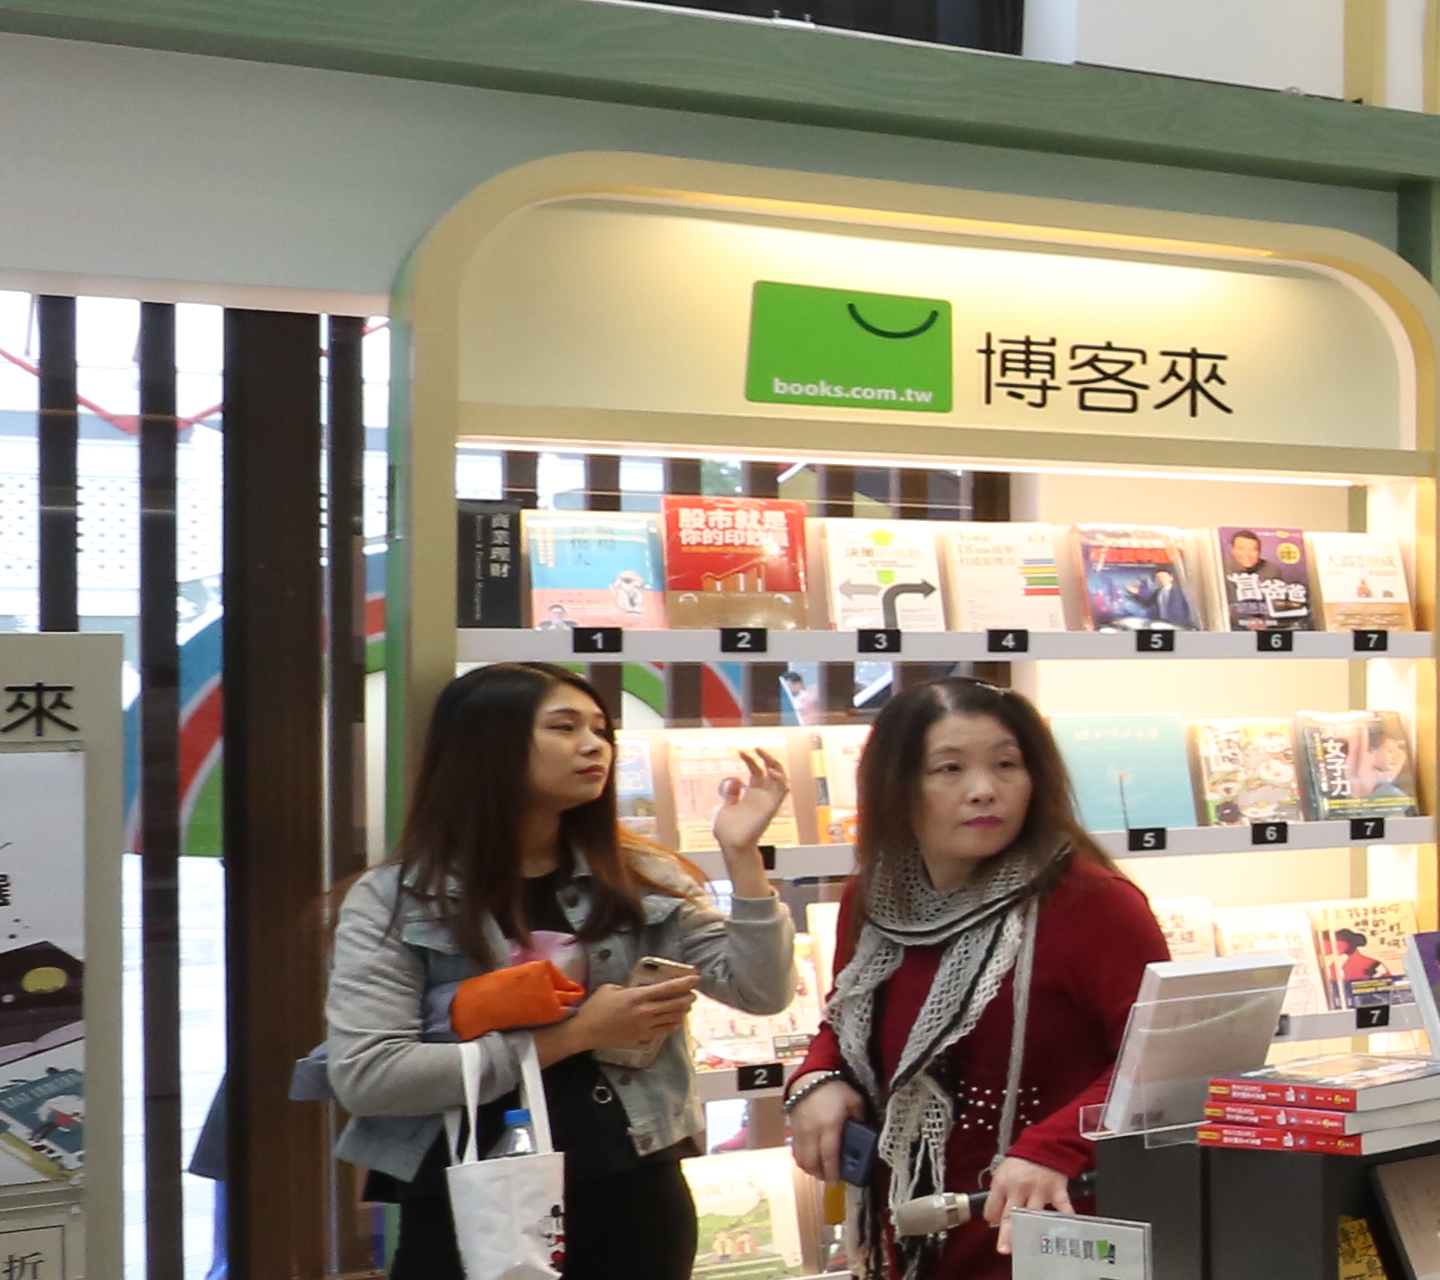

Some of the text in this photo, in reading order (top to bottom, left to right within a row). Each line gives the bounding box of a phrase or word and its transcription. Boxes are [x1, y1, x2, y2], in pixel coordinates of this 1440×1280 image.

[975, 331, 1235, 418] 博客來
[772, 376, 934, 405] books.com.tw
[678, 507, 788, 531] 股市就是
[592, 632, 604, 649] 1
[737, 632, 752, 648] 2
[874, 633, 888, 649] 3
[1001, 633, 1016, 649] 4
[1150, 634, 1163, 649] 5
[1271, 634, 1282, 648] 6
[1367, 633, 1378, 648] 7
[1, 681, 80, 738] 來
[1323, 738, 1352, 797] 女子力
[1265, 825, 1277, 841] 6
[1364, 821, 1375, 836] 7
[1142, 832, 1156, 848] 5
[1369, 1008, 1380, 1025] 7
[754, 1067, 769, 1087] 2
